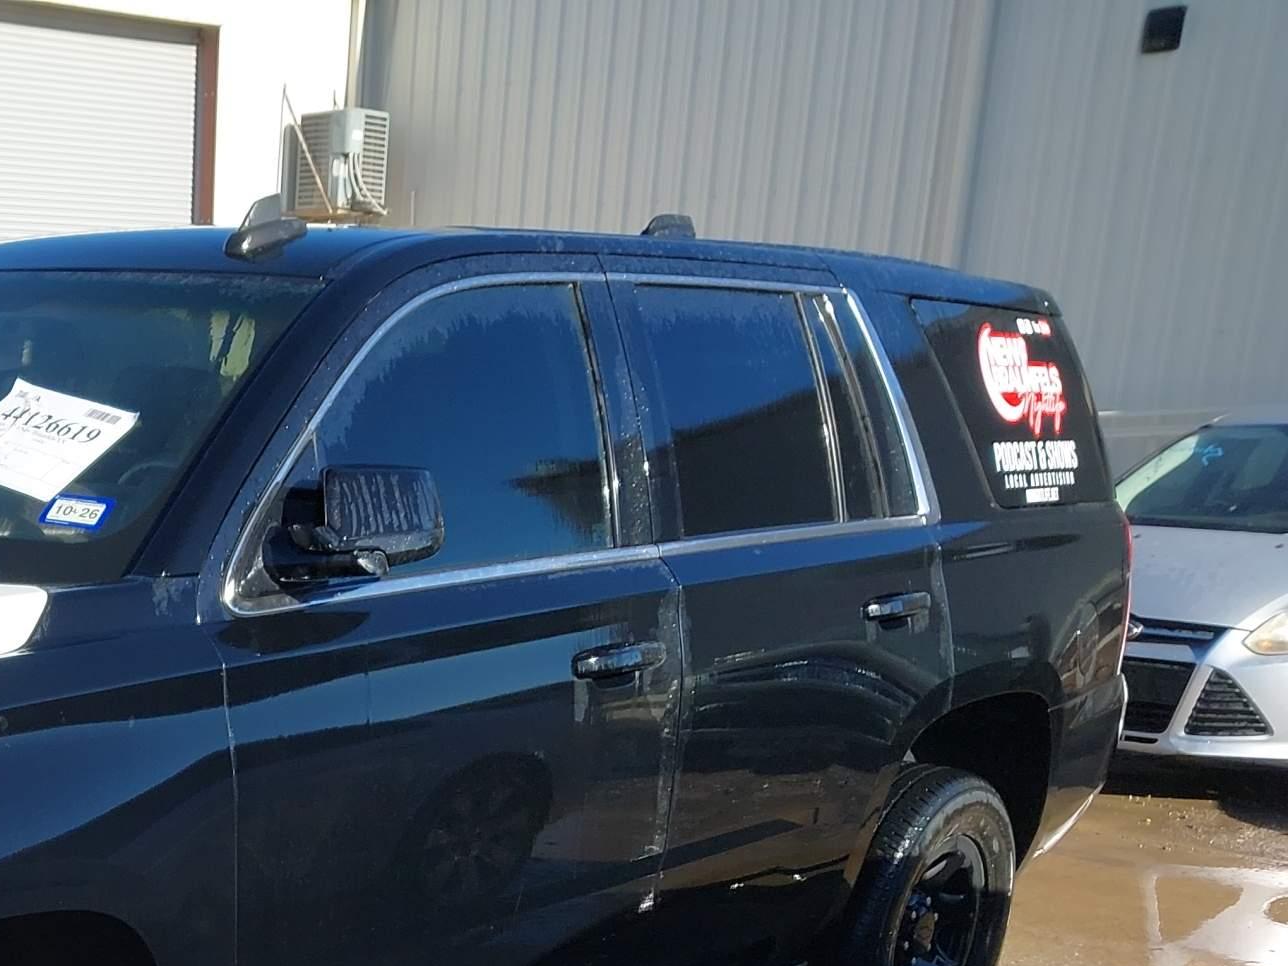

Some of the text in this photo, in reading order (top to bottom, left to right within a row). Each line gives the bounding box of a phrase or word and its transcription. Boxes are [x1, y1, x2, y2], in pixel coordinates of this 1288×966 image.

[1, 406, 102, 443] 44126619
[993, 440, 1079, 472] PODCAST & SHOWS
[1004, 473, 1028, 489] LOCAL
